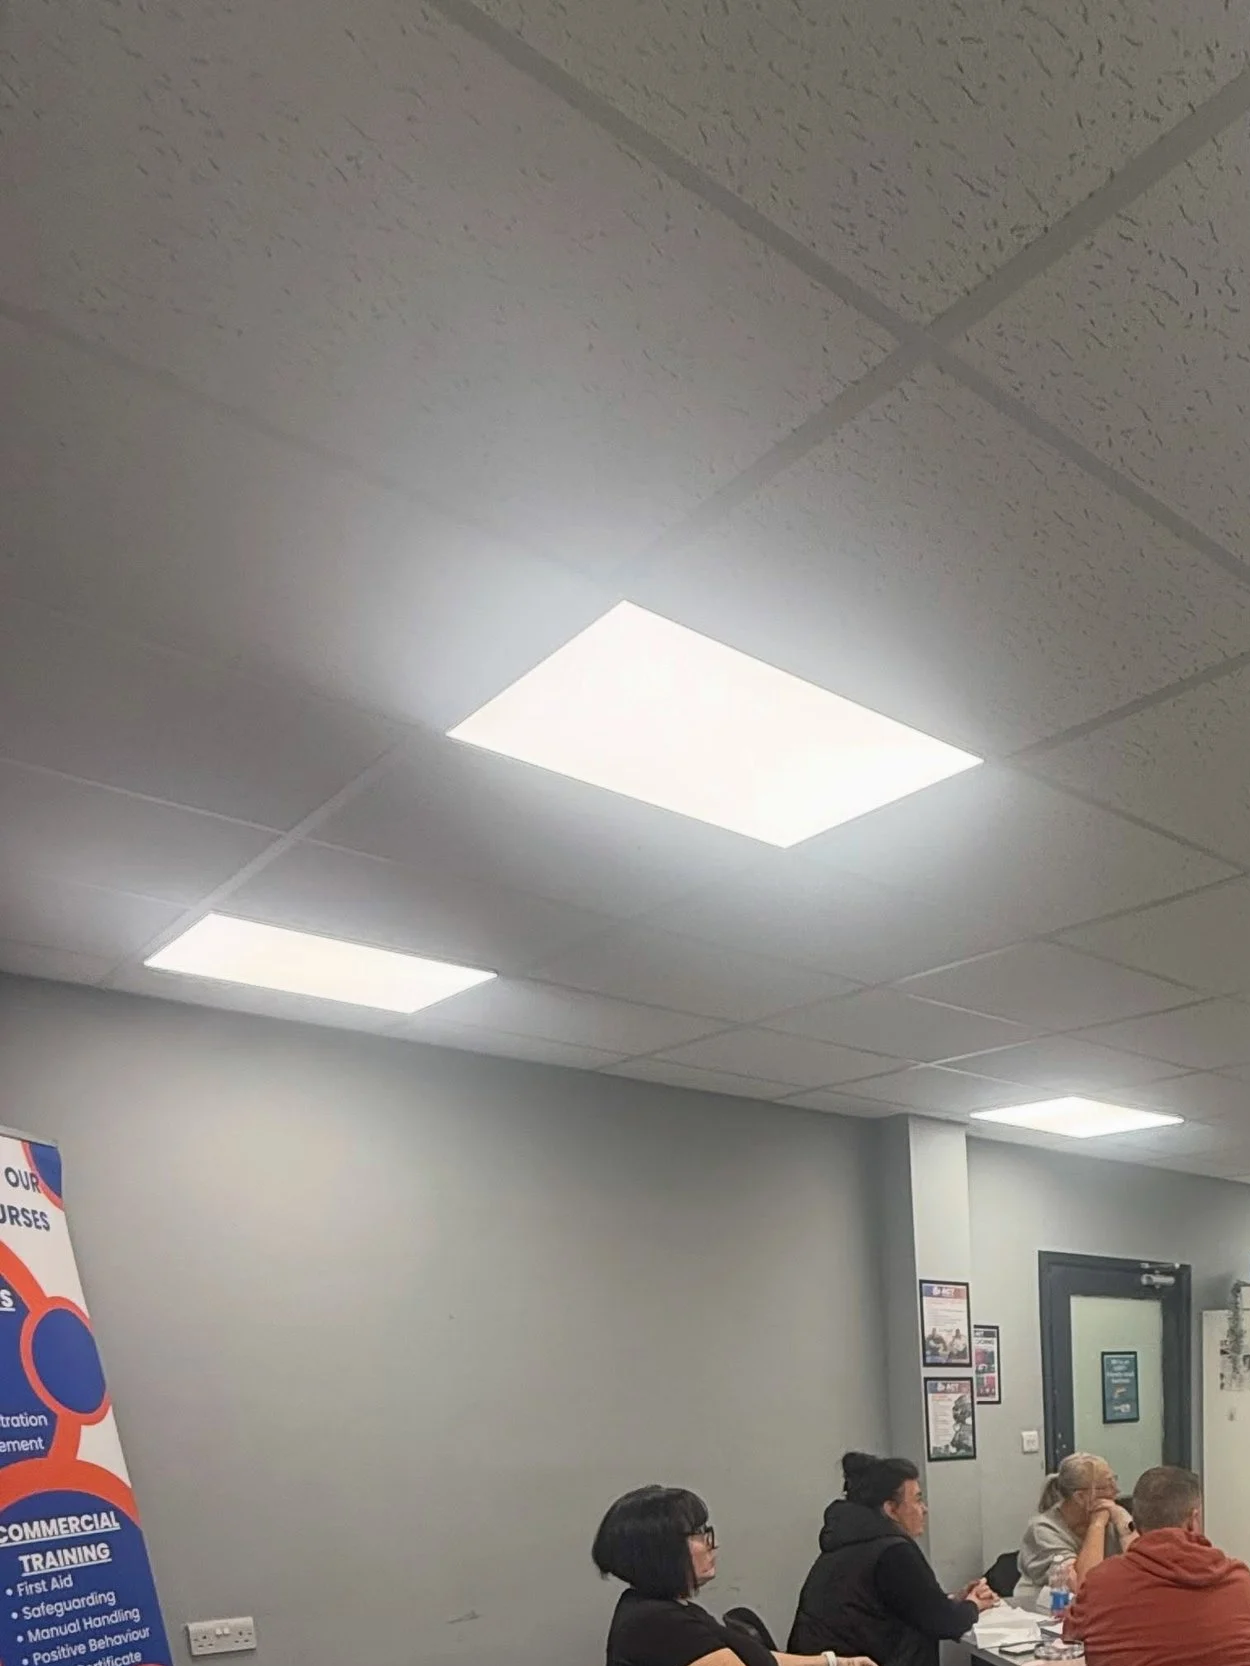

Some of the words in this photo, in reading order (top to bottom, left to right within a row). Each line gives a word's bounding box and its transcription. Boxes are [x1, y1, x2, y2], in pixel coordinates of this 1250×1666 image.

[4, 1166, 42, 1194] OUR
[0, 1511, 120, 1544] COMMERCIAL
[18, 1543, 110, 1572] TRAINING
[17, 1579, 48, 1597] First
[51, 1574, 73, 1591] Aid
[22, 1591, 116, 1620] Safeguarding
[27, 1618, 81, 1643] Manual
[83, 1607, 141, 1630] Handling
[33, 1643, 86, 1666] Positive
[88, 1626, 150, 1652] Behaviour
